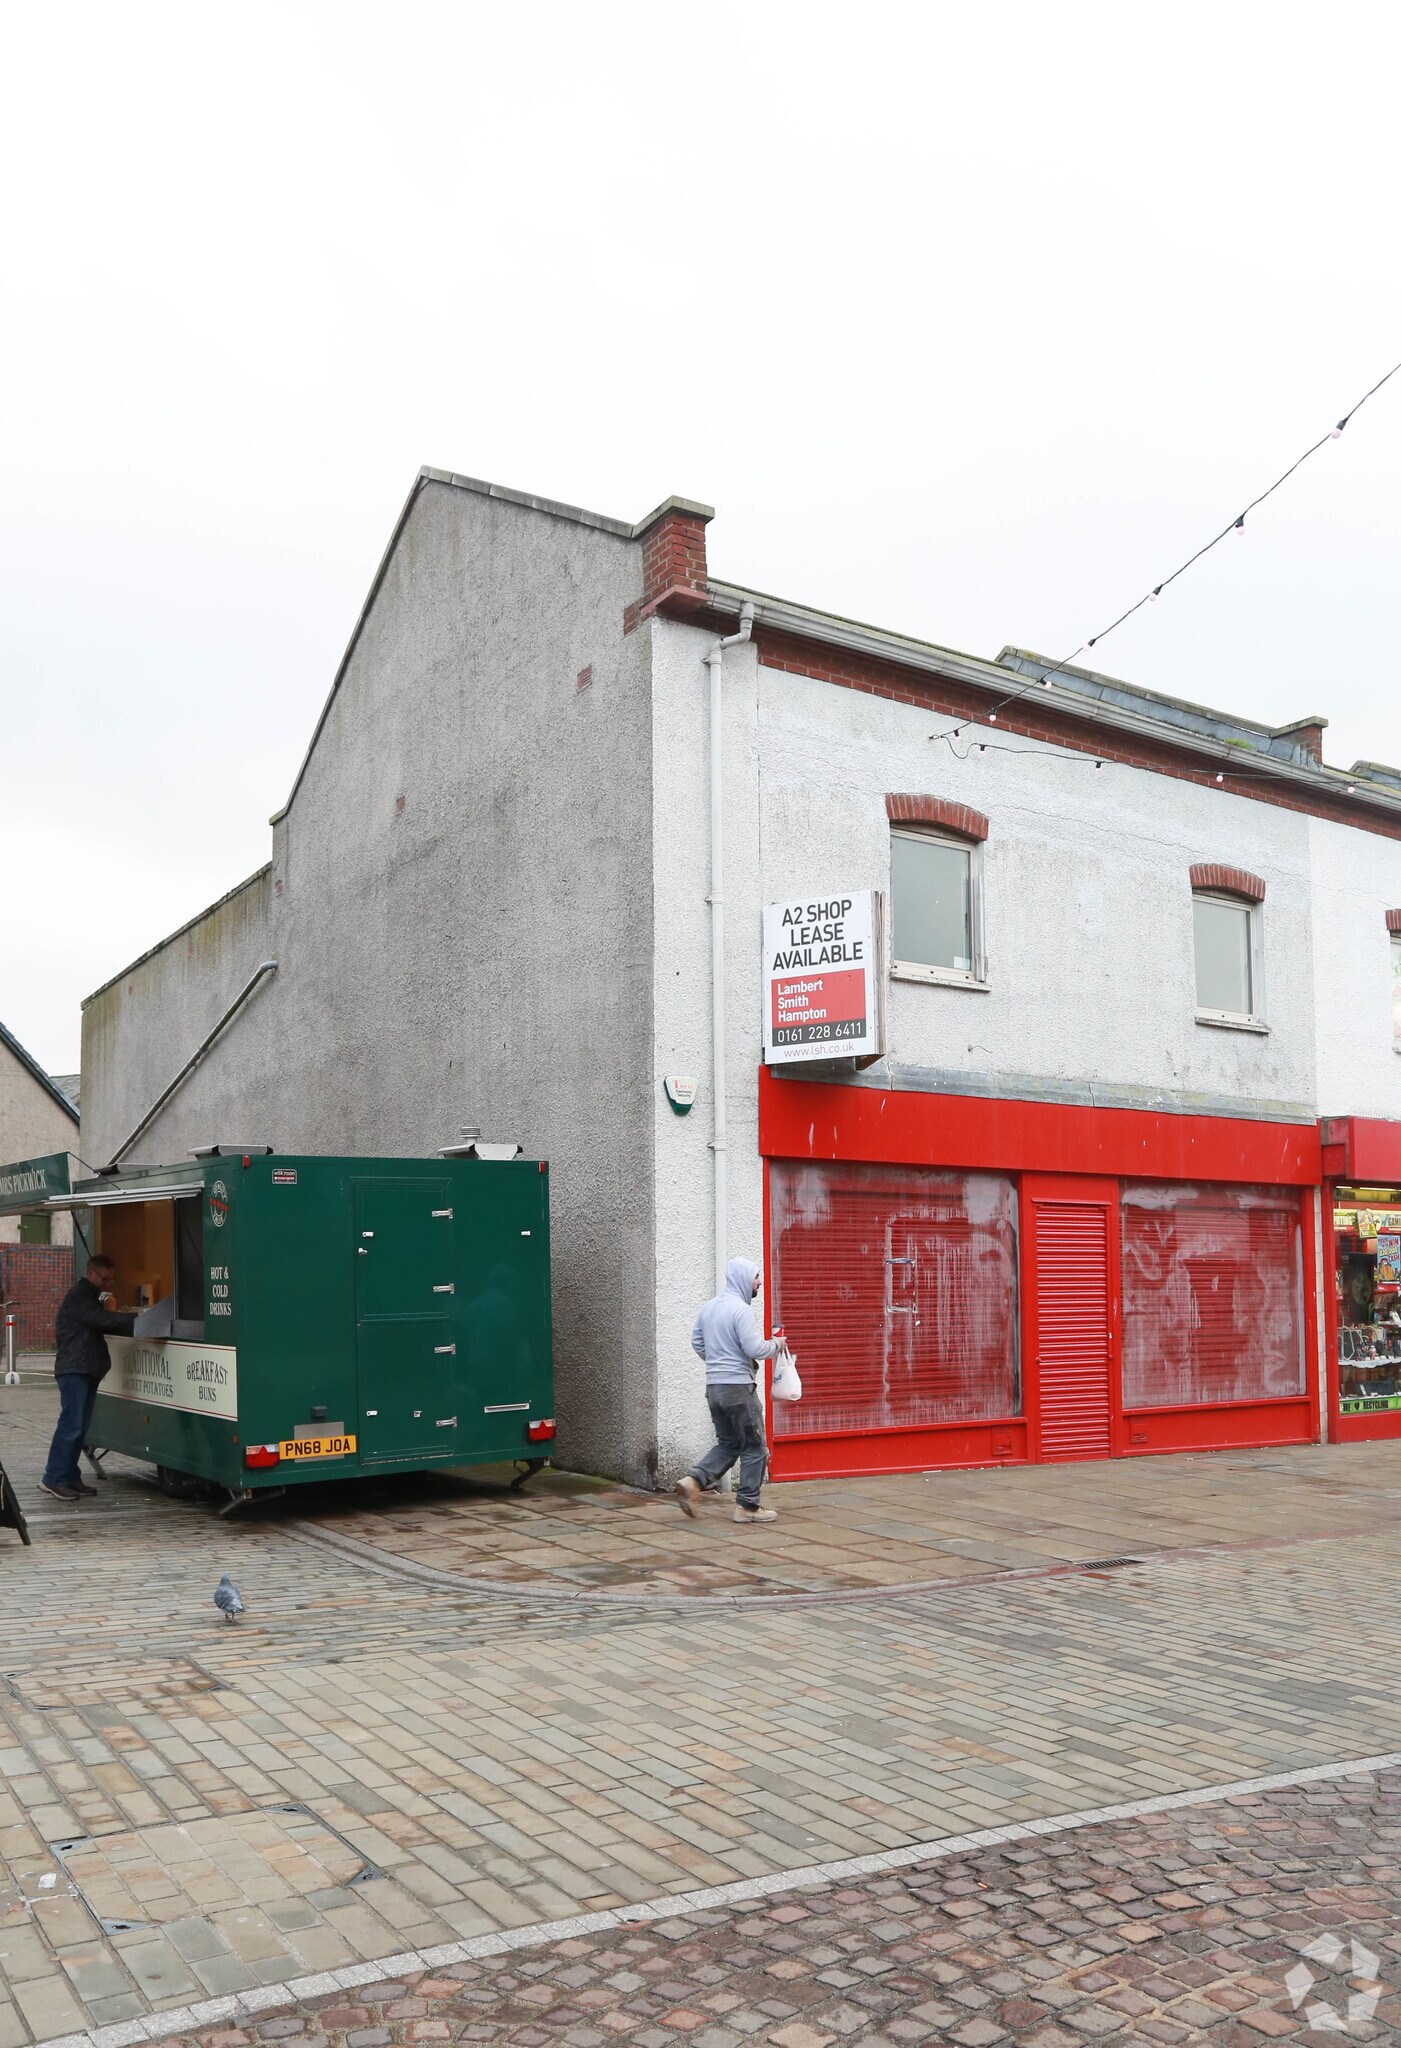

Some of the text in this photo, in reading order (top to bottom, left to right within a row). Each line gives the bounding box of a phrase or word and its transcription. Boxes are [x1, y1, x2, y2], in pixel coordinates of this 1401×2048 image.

[782, 899, 852, 927] A2 SHOP
[791, 922, 845, 947] LEASE
[773, 941, 864, 971] AVAILABLE
[778, 980, 824, 996] Lambert
[778, 995, 809, 1010] Smith
[778, 1008, 827, 1023] Hampton
[778, 1022, 862, 1043] 0161 228 6411
[784, 1041, 855, 1058] www.lsh.co.uk
[12, 1168, 48, 1194] PICKWICK
[210, 1266, 229, 1280] HOT &
[212, 1284, 229, 1298] COLD
[209, 1302, 232, 1316] DRINKS
[186, 1359, 229, 1386] BREAKFAST
[143, 1380, 174, 1399] POTATOES
[198, 1385, 217, 1402] BUNS
[285, 1436, 351, 1457] PN68 JOA
